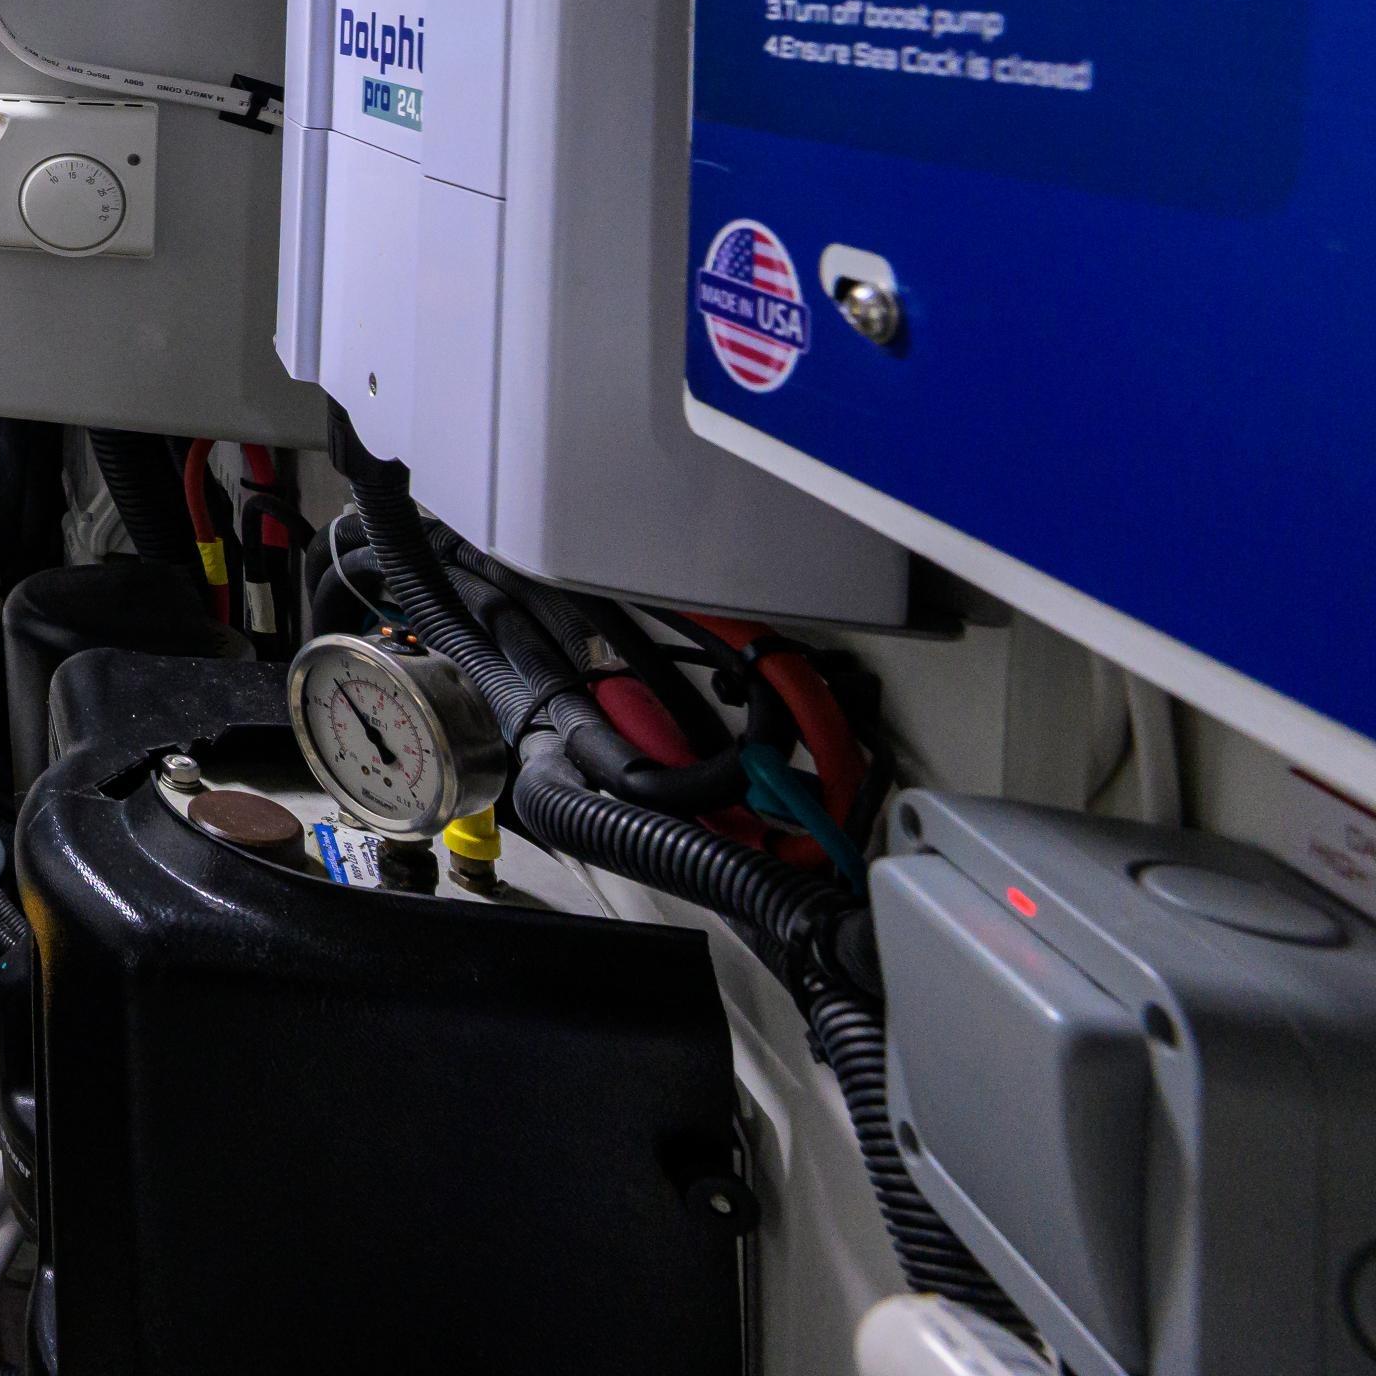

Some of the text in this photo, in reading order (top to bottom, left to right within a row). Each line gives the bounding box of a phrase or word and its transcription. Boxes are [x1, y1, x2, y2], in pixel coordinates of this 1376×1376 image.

[832, 0, 863, 25] off
[864, 2, 931, 31] boost
[932, 9, 1005, 42] pump
[853, 42, 899, 71] Sea
[900, 46, 964, 77] Cock
[965, 50, 991, 81] is
[992, 54, 1093, 92] closed
[123, 77, 145, 87] 600V
[156, 83, 179, 96] COND
[363, 79, 423, 122] pro 24.
[49, 175, 59, 185] 10
[68, 171, 77, 180] 15
[85, 175, 96, 185] 20
[96, 187, 108, 198] 25
[101, 204, 110, 213] 30
[701, 284, 805, 342] MADE IN USA
